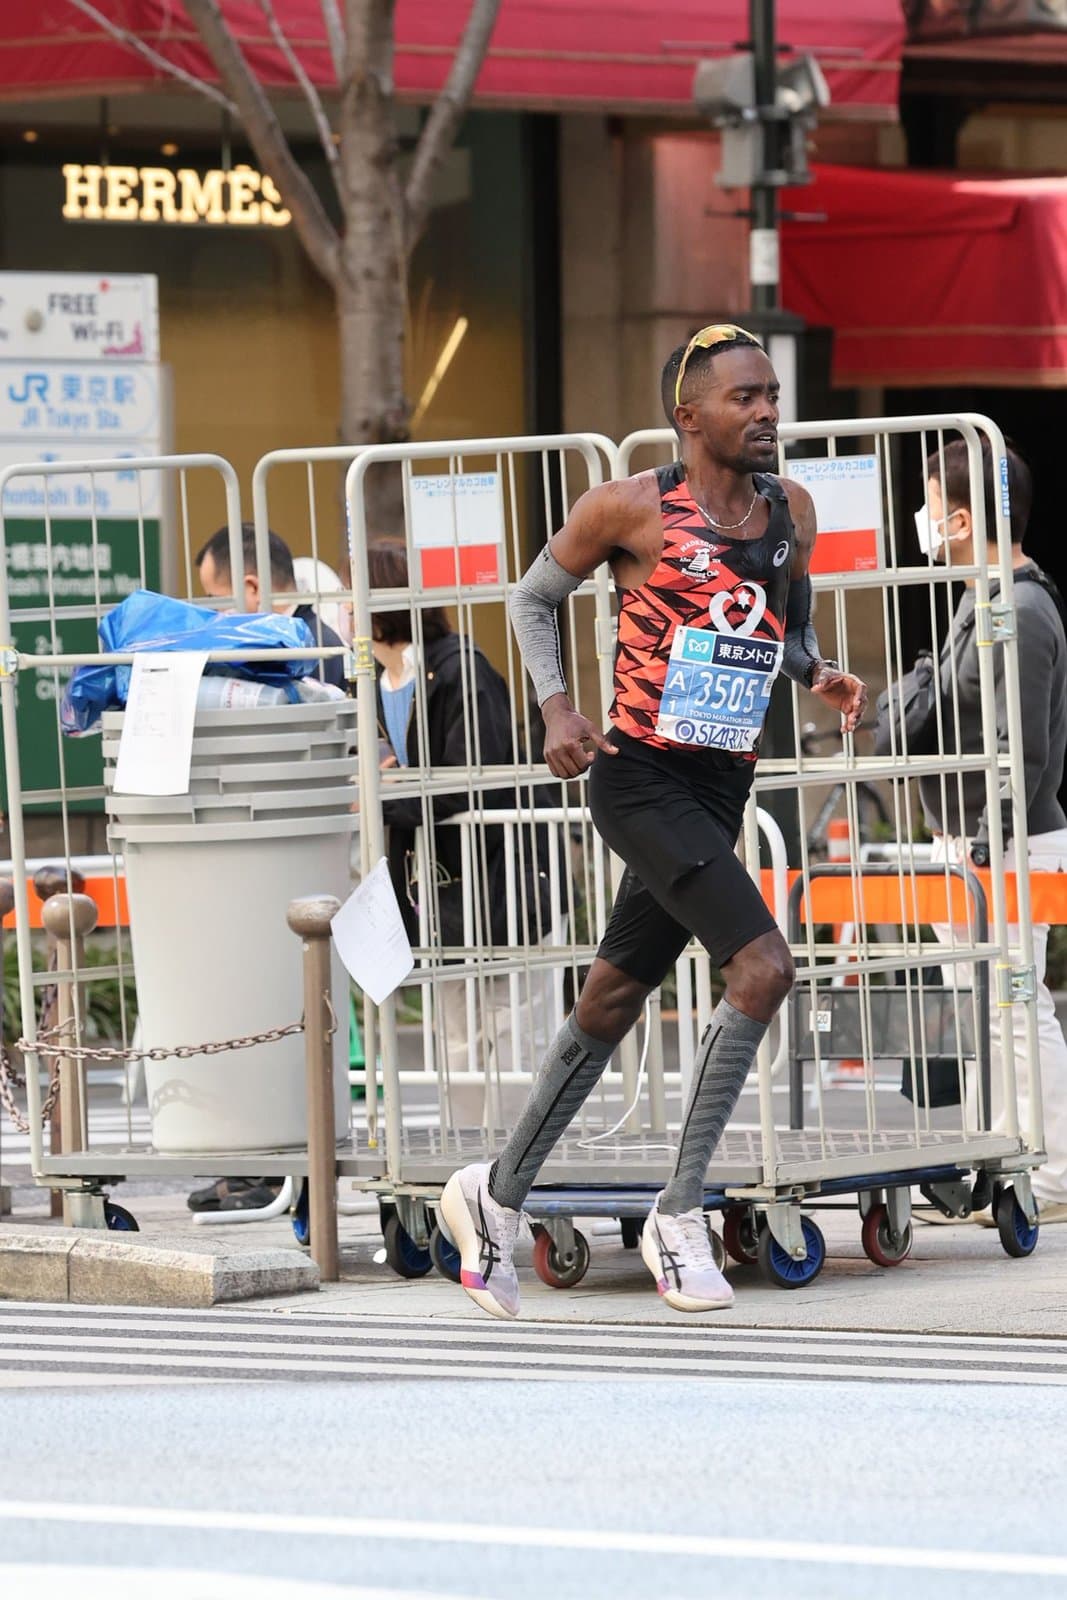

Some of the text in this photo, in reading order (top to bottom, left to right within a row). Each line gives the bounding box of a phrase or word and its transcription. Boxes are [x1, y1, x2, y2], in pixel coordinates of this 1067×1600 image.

[48, 293, 98, 316] FREE
[71, 320, 124, 342] Wi-Fi
[9, 373, 135, 405] JR 東京駅
[717, 643, 775, 665] 東京メトロ
[667, 670, 686, 691] A
[693, 671, 760, 714] 3505
[668, 699, 676, 713] 1
[688, 708, 712, 719] TOKYO
[696, 723, 750, 750] STARTS
